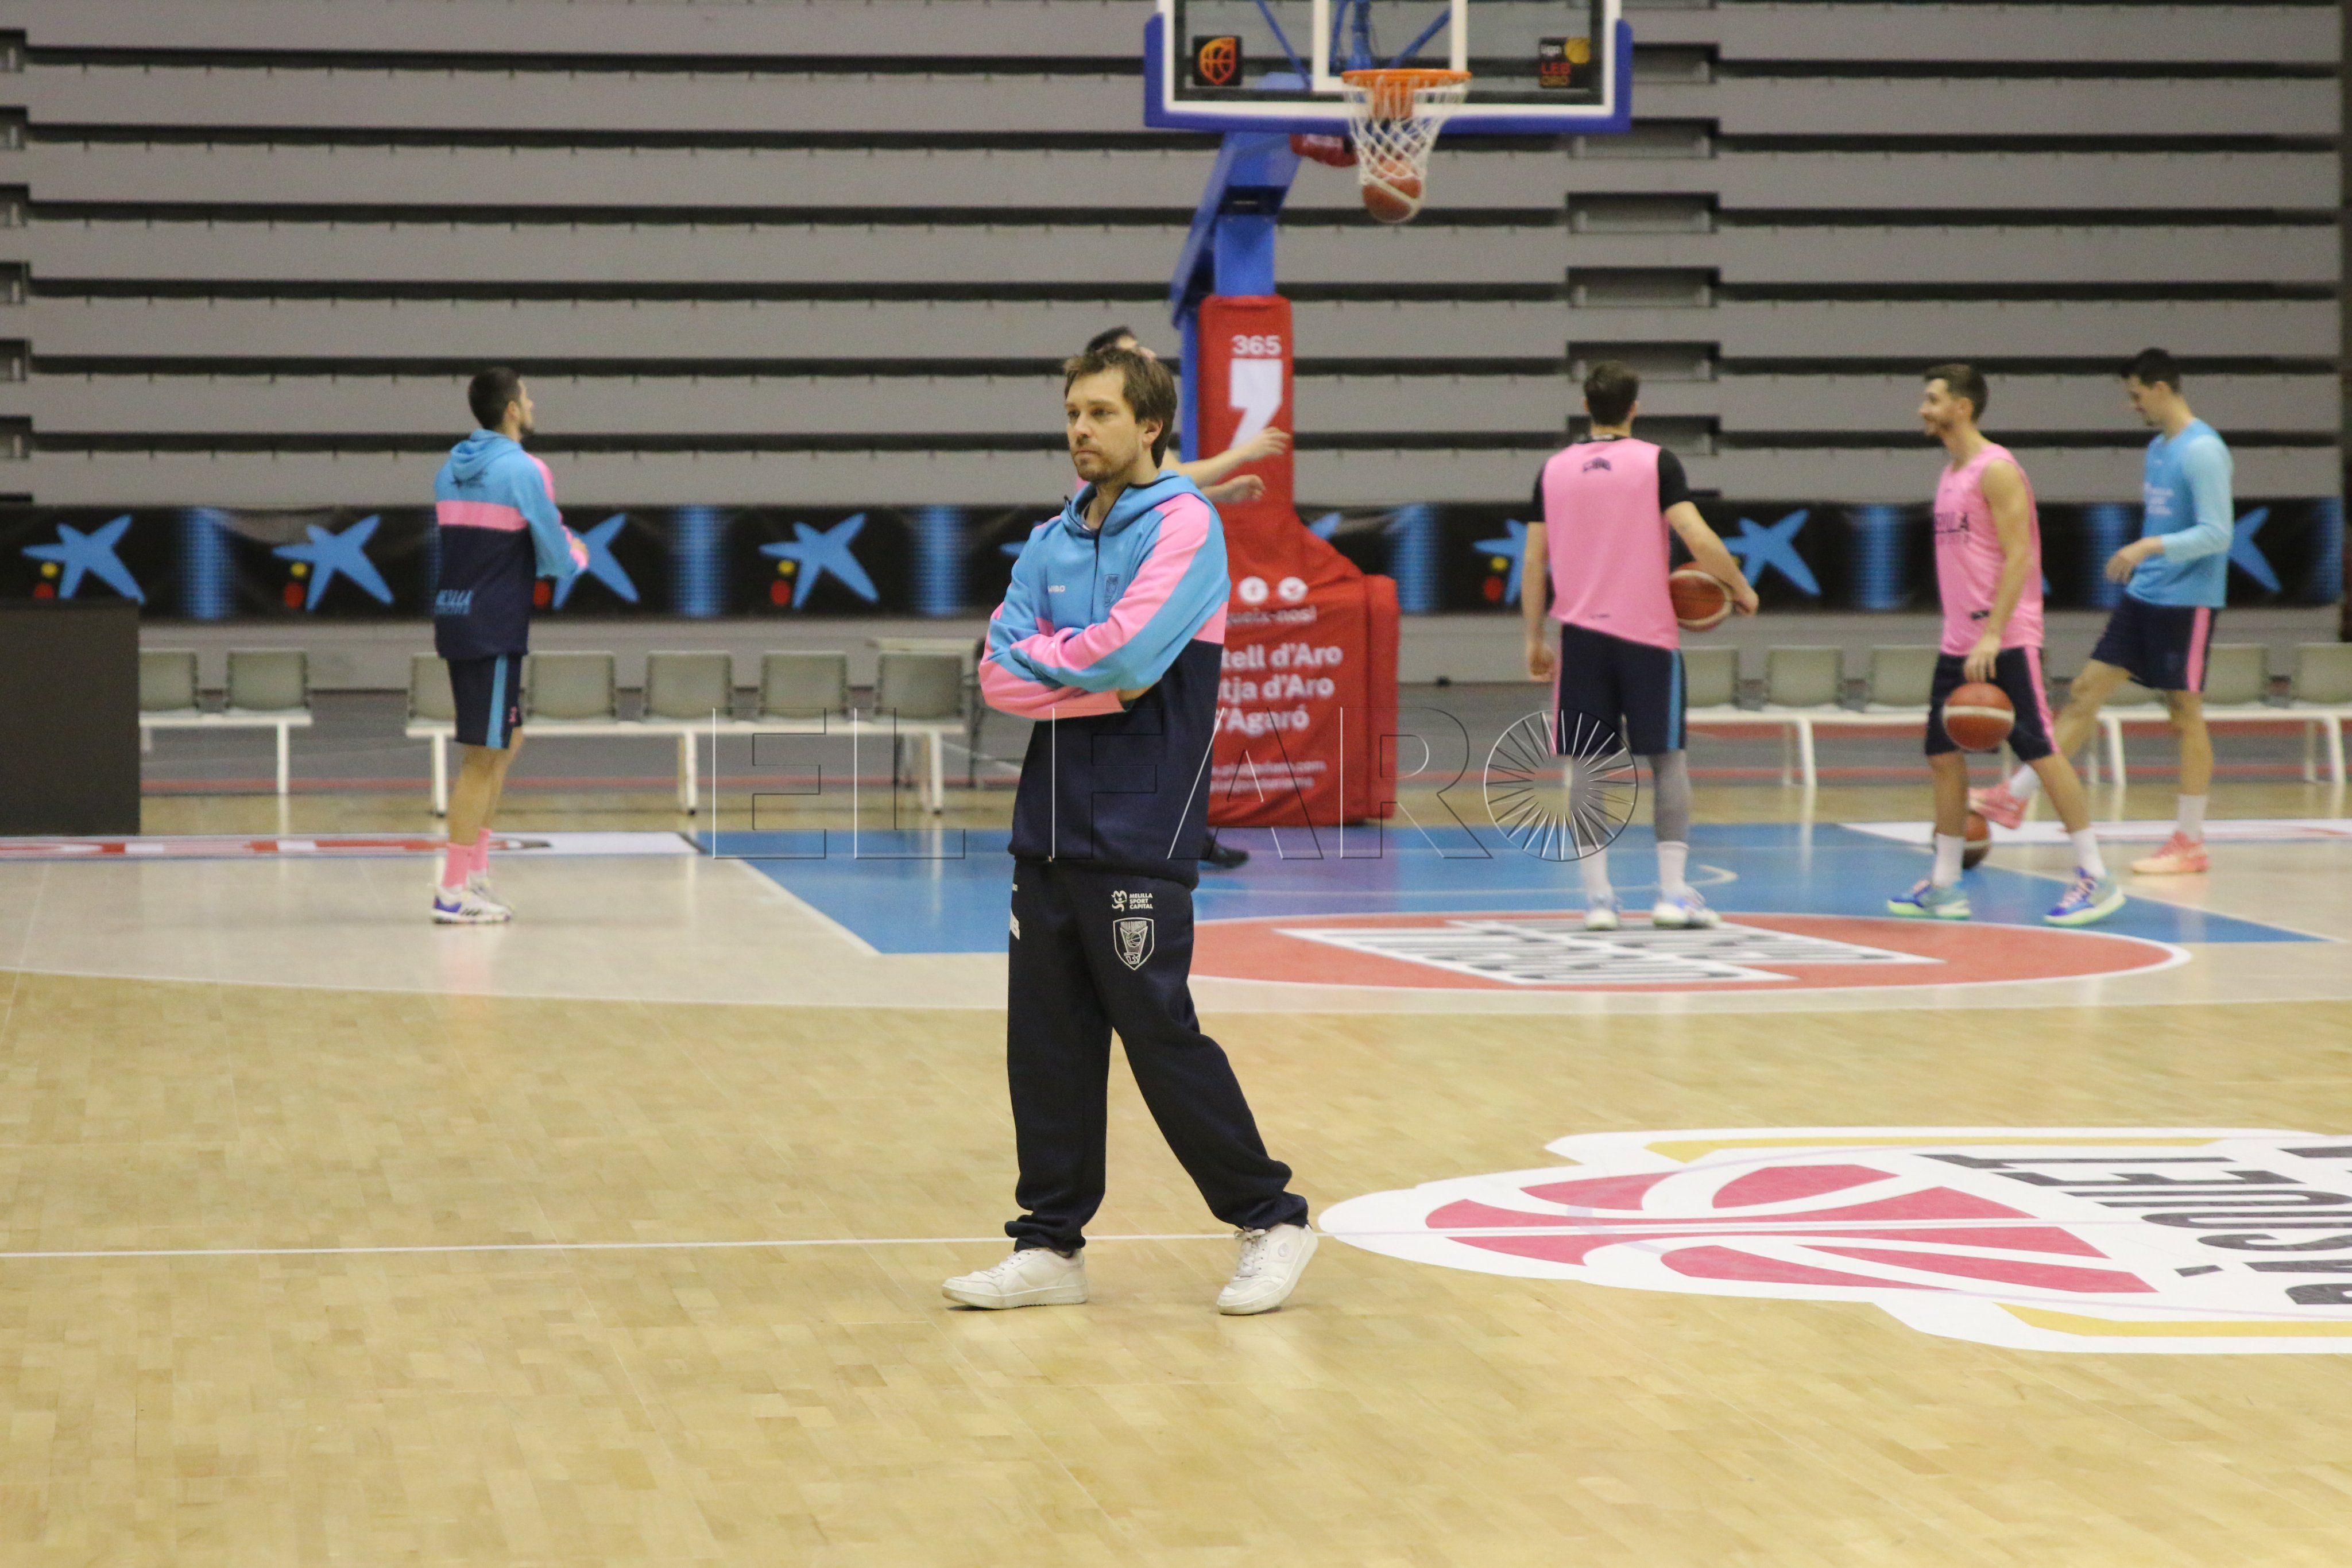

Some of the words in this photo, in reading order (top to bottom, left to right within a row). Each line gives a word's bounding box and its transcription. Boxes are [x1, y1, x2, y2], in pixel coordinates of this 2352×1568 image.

[1231, 334, 1282, 356] 365
[1221, 644, 1265, 669] tell
[1270, 642, 1344, 667] d'Aro
[1218, 676, 1258, 704] tja
[1262, 674, 1336, 699] d'Aro
